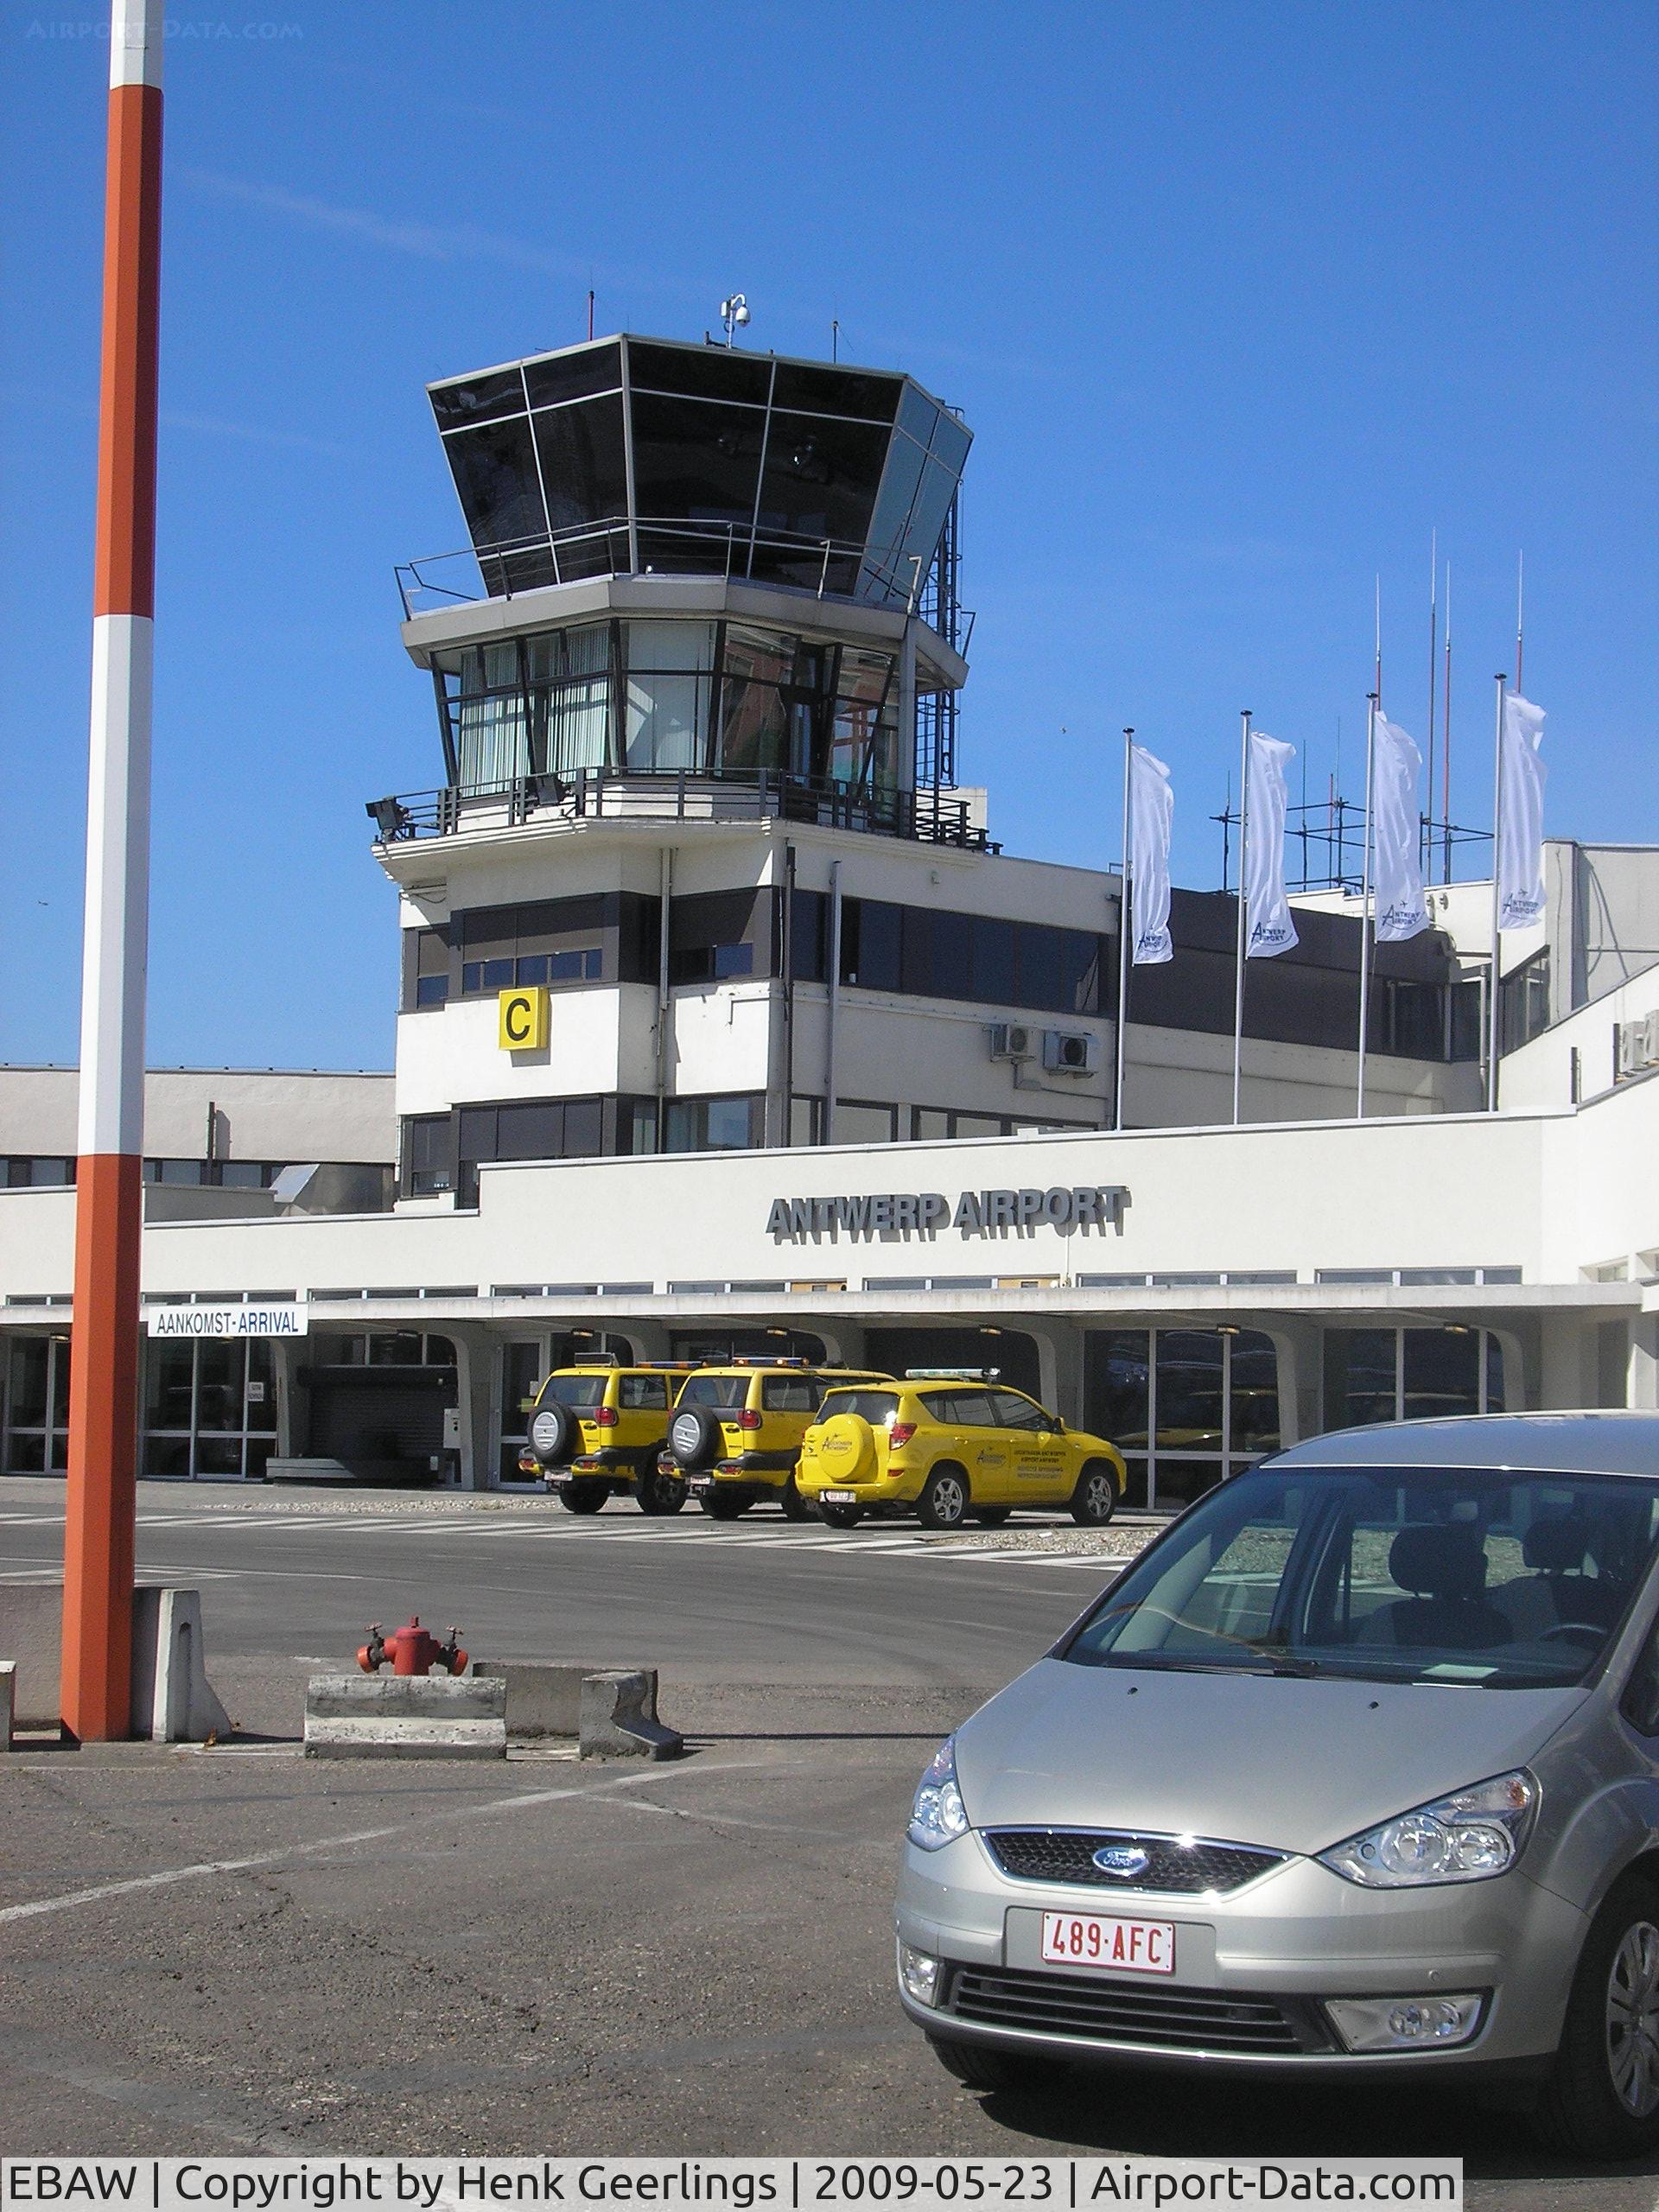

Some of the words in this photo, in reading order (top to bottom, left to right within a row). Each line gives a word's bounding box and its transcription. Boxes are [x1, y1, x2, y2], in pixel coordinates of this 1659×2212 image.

[505, 997, 531, 1041] C
[766, 1193, 944, 1234] ANTWERP
[952, 1185, 1128, 1229] AIRPORT
